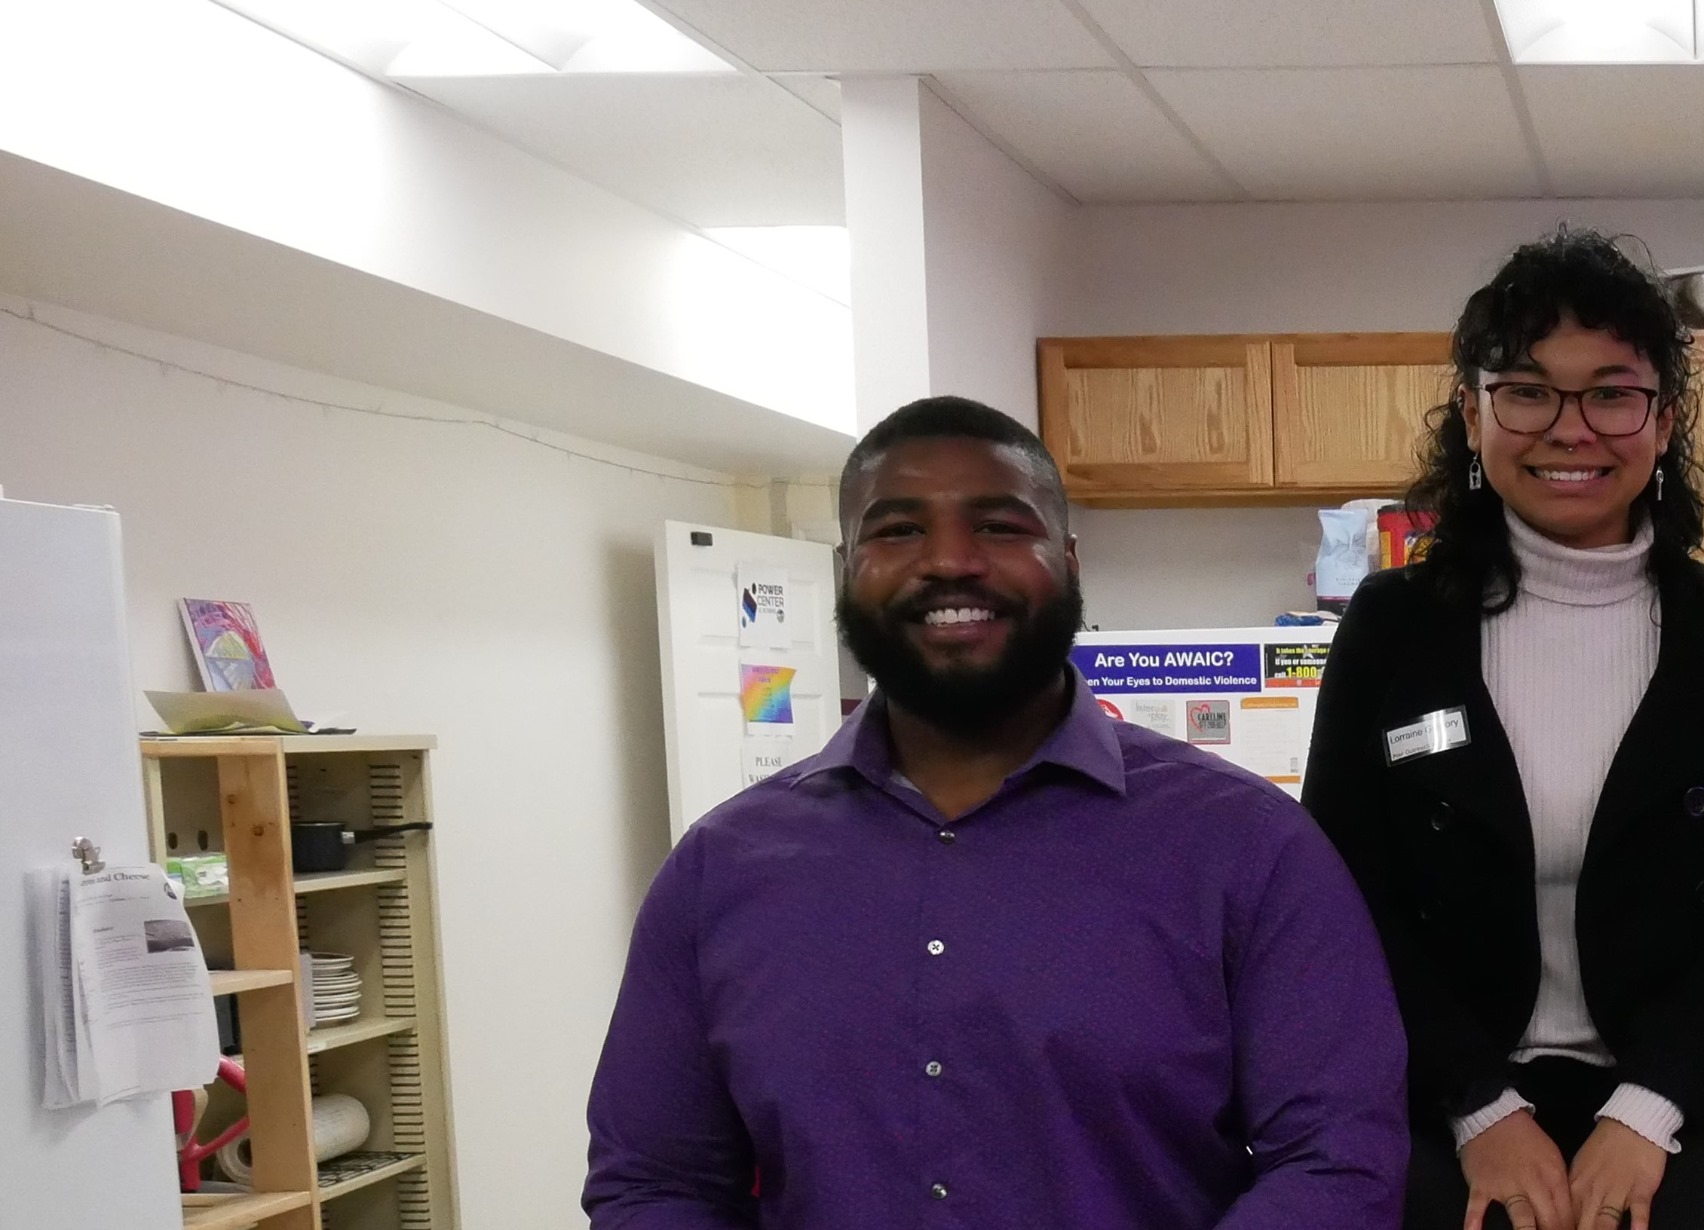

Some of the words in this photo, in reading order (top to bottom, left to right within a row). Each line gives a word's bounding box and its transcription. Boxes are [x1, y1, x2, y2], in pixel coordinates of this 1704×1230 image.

[757, 584, 784, 596] POWER
[757, 595, 785, 608] CENTER
[1095, 652, 1125, 668] Are
[1128, 652, 1160, 668] You
[1164, 651, 1234, 667] AWAIC?
[1101, 676, 1124, 687] Your
[1126, 676, 1150, 688] Eyes
[1152, 676, 1163, 687] to
[1165, 675, 1212, 686] Domestic
[1214, 675, 1257, 686] Violence
[1390, 728, 1423, 744] Lorraine
[755, 756, 782, 767] PLEASE
